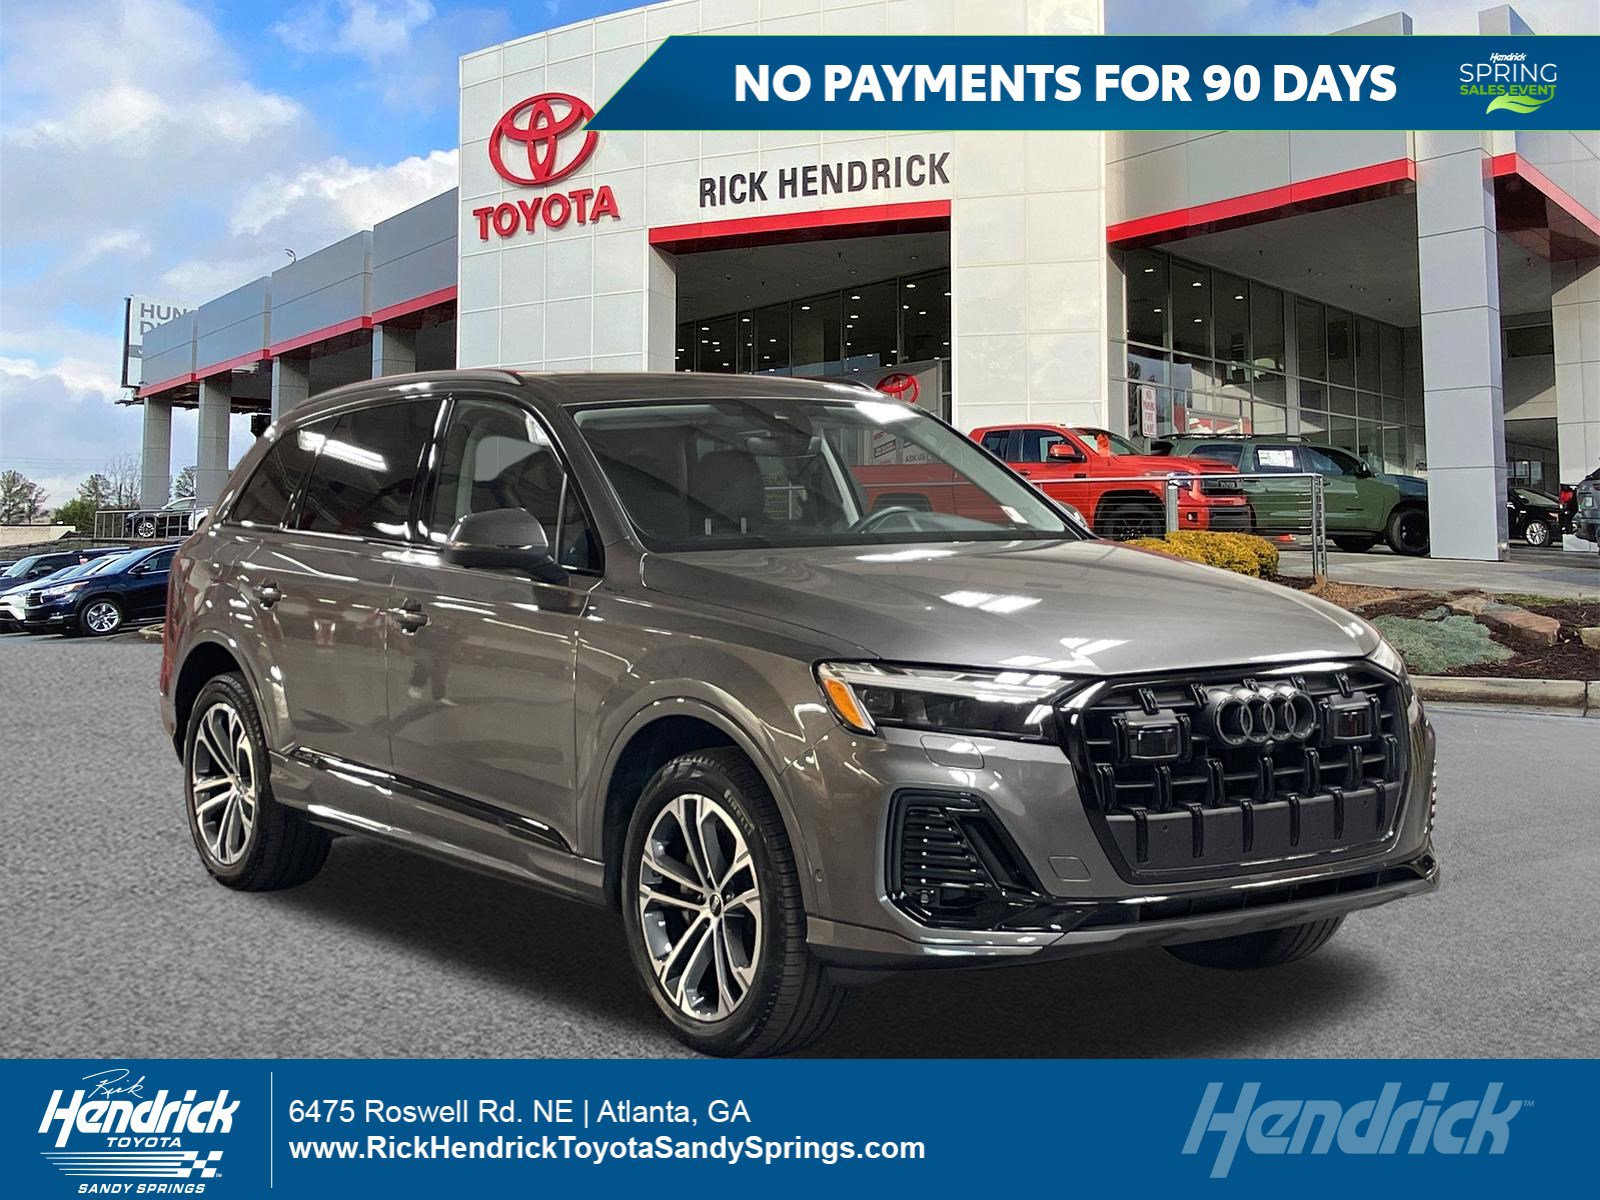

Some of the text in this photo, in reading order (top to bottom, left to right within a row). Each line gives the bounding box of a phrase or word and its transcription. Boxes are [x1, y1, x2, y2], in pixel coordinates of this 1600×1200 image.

[699, 151, 951, 208] RICK HENDRICK
[472, 185, 621, 241] TOYOTA
